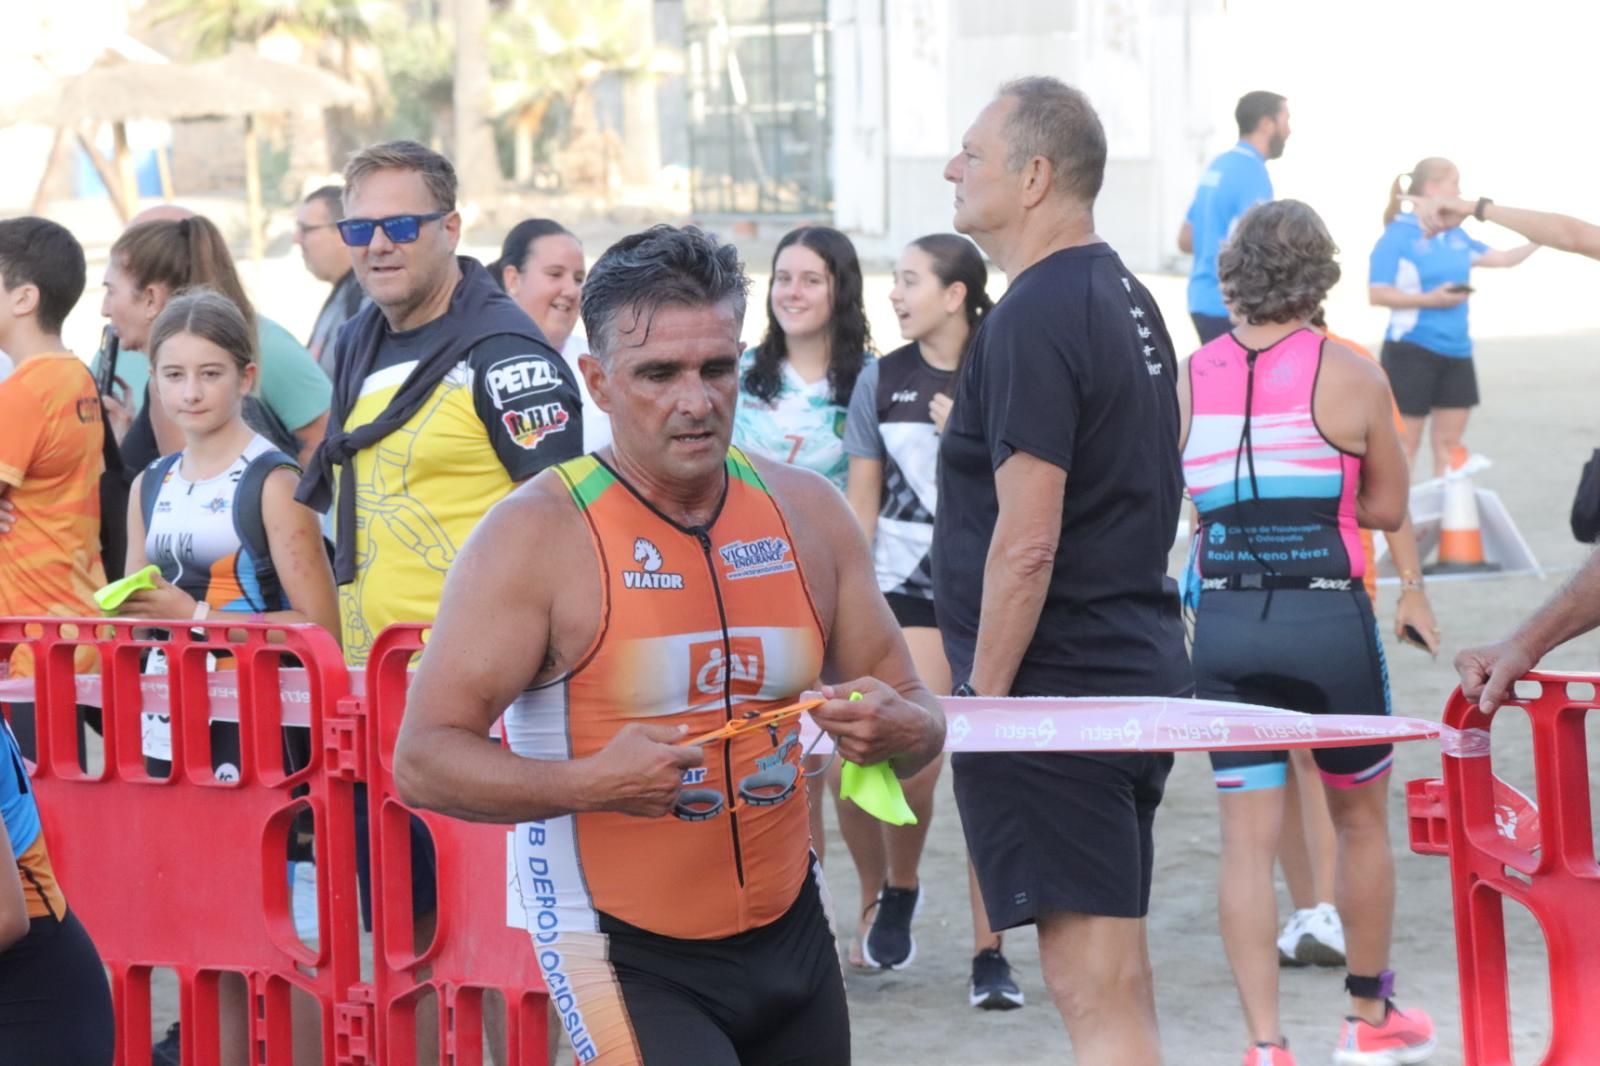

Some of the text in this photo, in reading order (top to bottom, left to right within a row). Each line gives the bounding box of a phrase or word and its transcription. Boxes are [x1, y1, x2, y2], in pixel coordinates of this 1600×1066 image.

[487, 360, 562, 409] PETZL
[784, 434, 804, 464] 7
[722, 539, 773, 562] VICTORY
[734, 550, 782, 569] ENDURANCE
[1208, 549, 1234, 561] Raúl
[1291, 547, 1329, 560] Pérez
[623, 571, 684, 589] VIATOR
